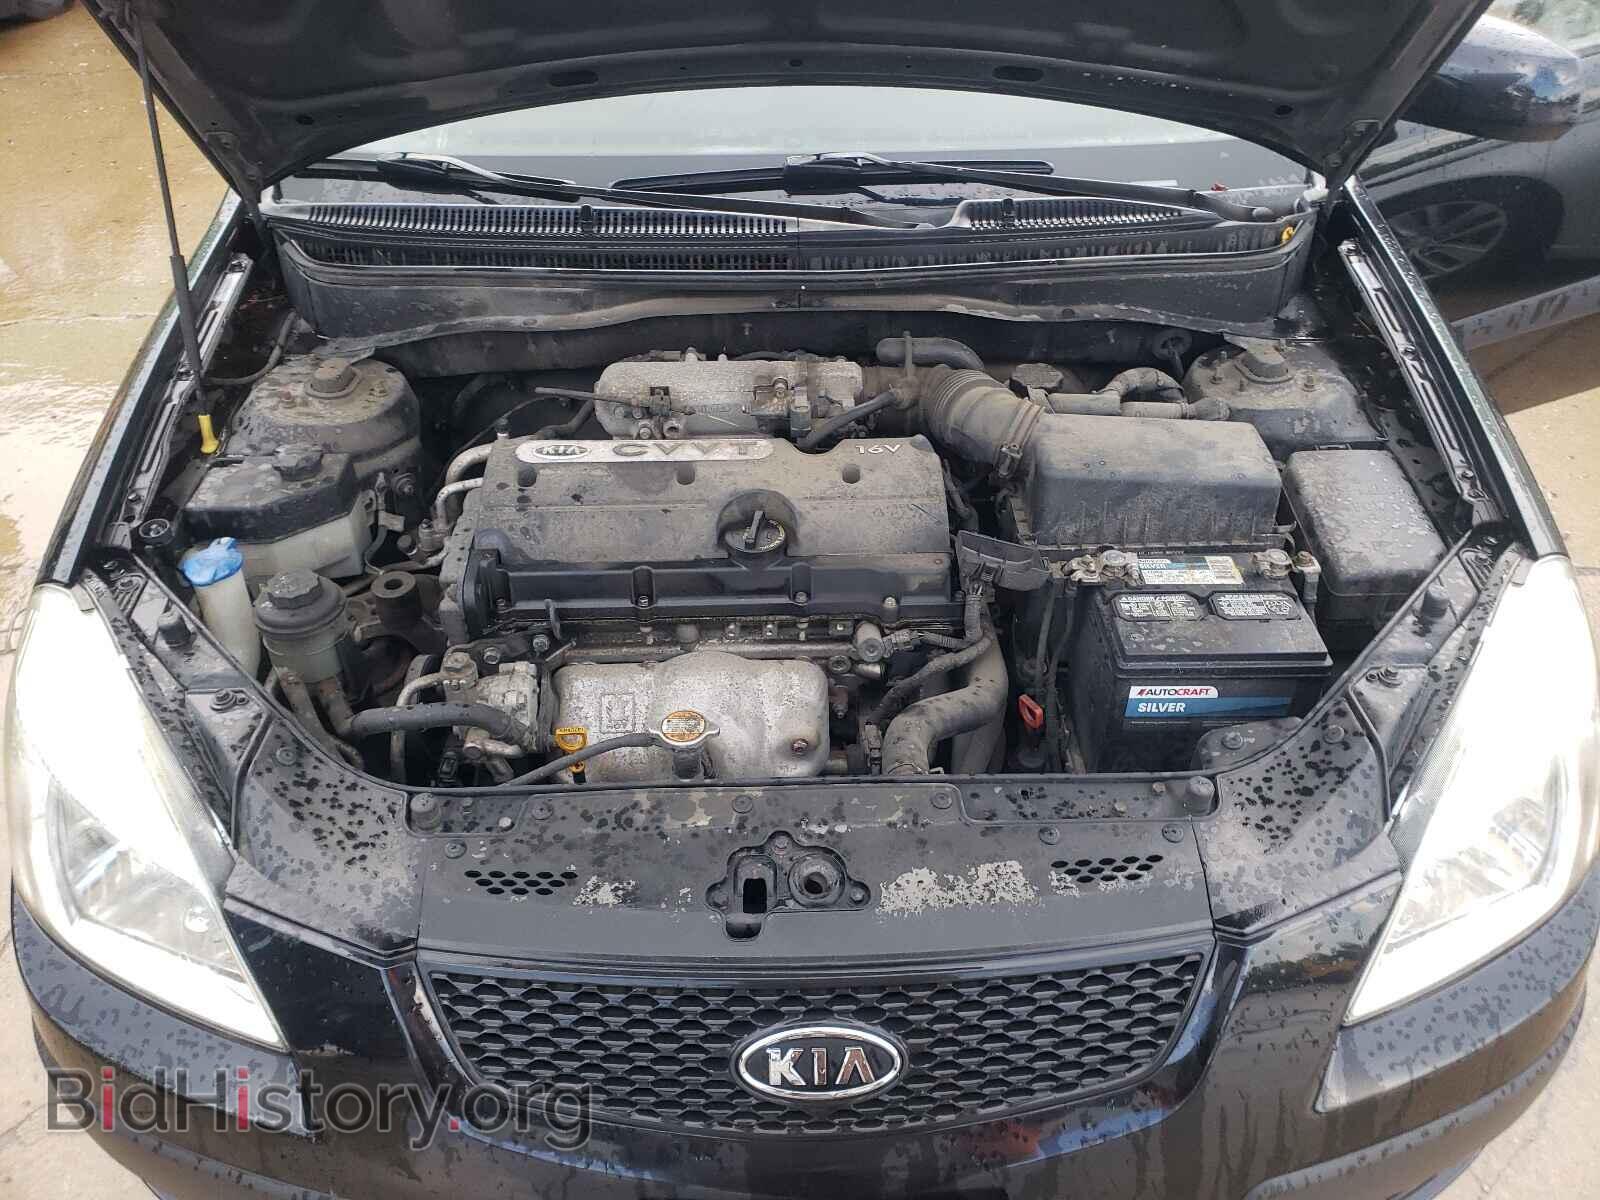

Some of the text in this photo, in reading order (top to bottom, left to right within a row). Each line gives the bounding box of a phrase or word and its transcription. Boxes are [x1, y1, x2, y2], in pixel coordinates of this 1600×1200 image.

[543, 442, 759, 457] KIA CVVT
[855, 444, 901, 455] 16V
[1145, 687, 1211, 697] AUTOCRAFT
[1137, 702, 1187, 713] SILVER
[766, 1047, 876, 1086] KIA
